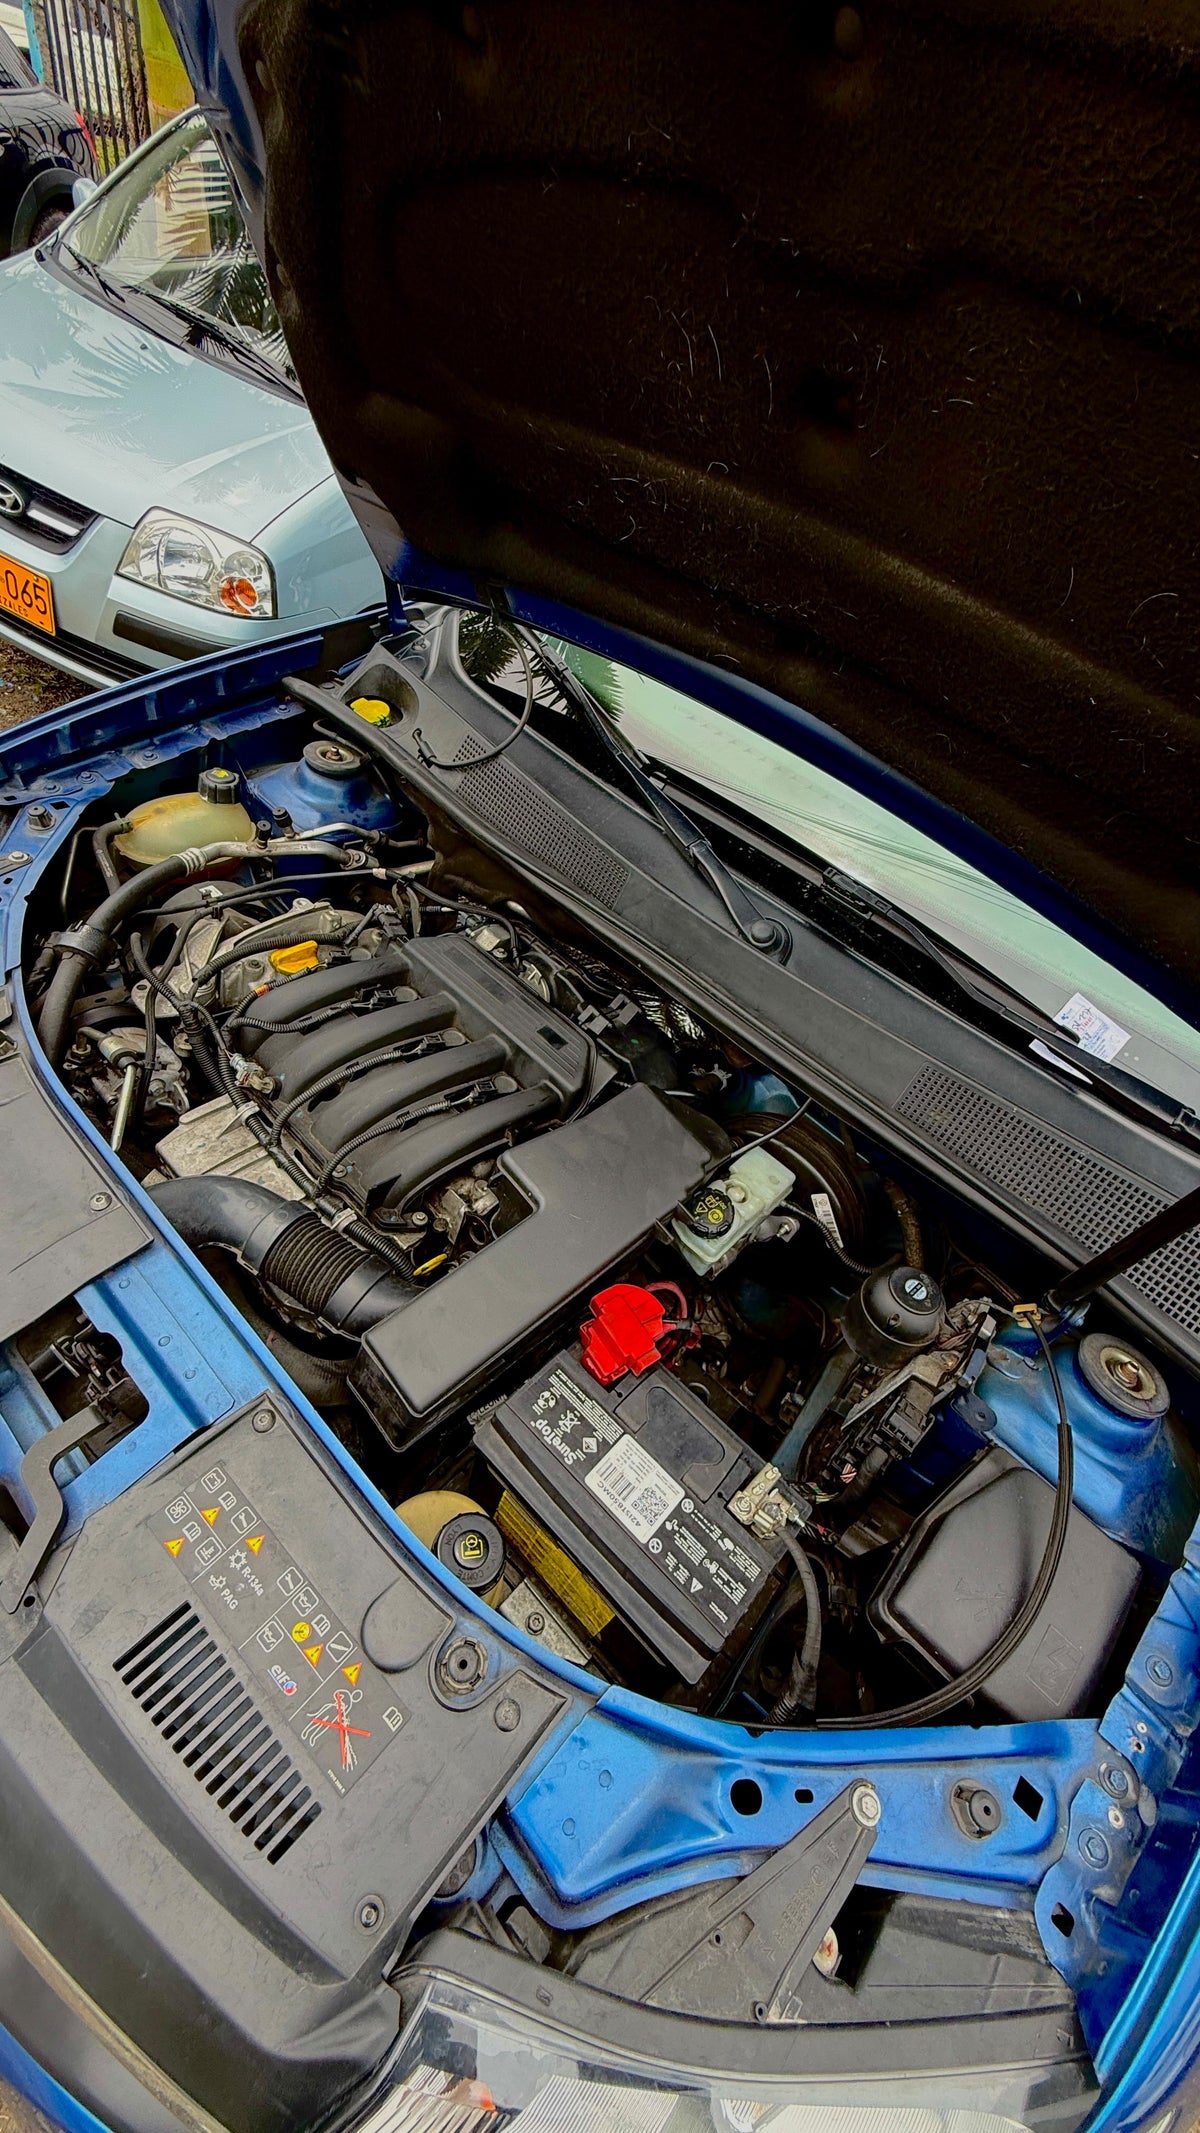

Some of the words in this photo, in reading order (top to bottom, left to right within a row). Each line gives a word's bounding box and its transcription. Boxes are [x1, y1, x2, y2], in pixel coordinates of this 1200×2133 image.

[0, 595, 28, 617] ZALES
[5, 569, 46, 614] 065
[535, 1419, 575, 1466] SureTop
[242, 1566, 264, 1597] R-134a
[220, 1588, 239, 1610] PAG
